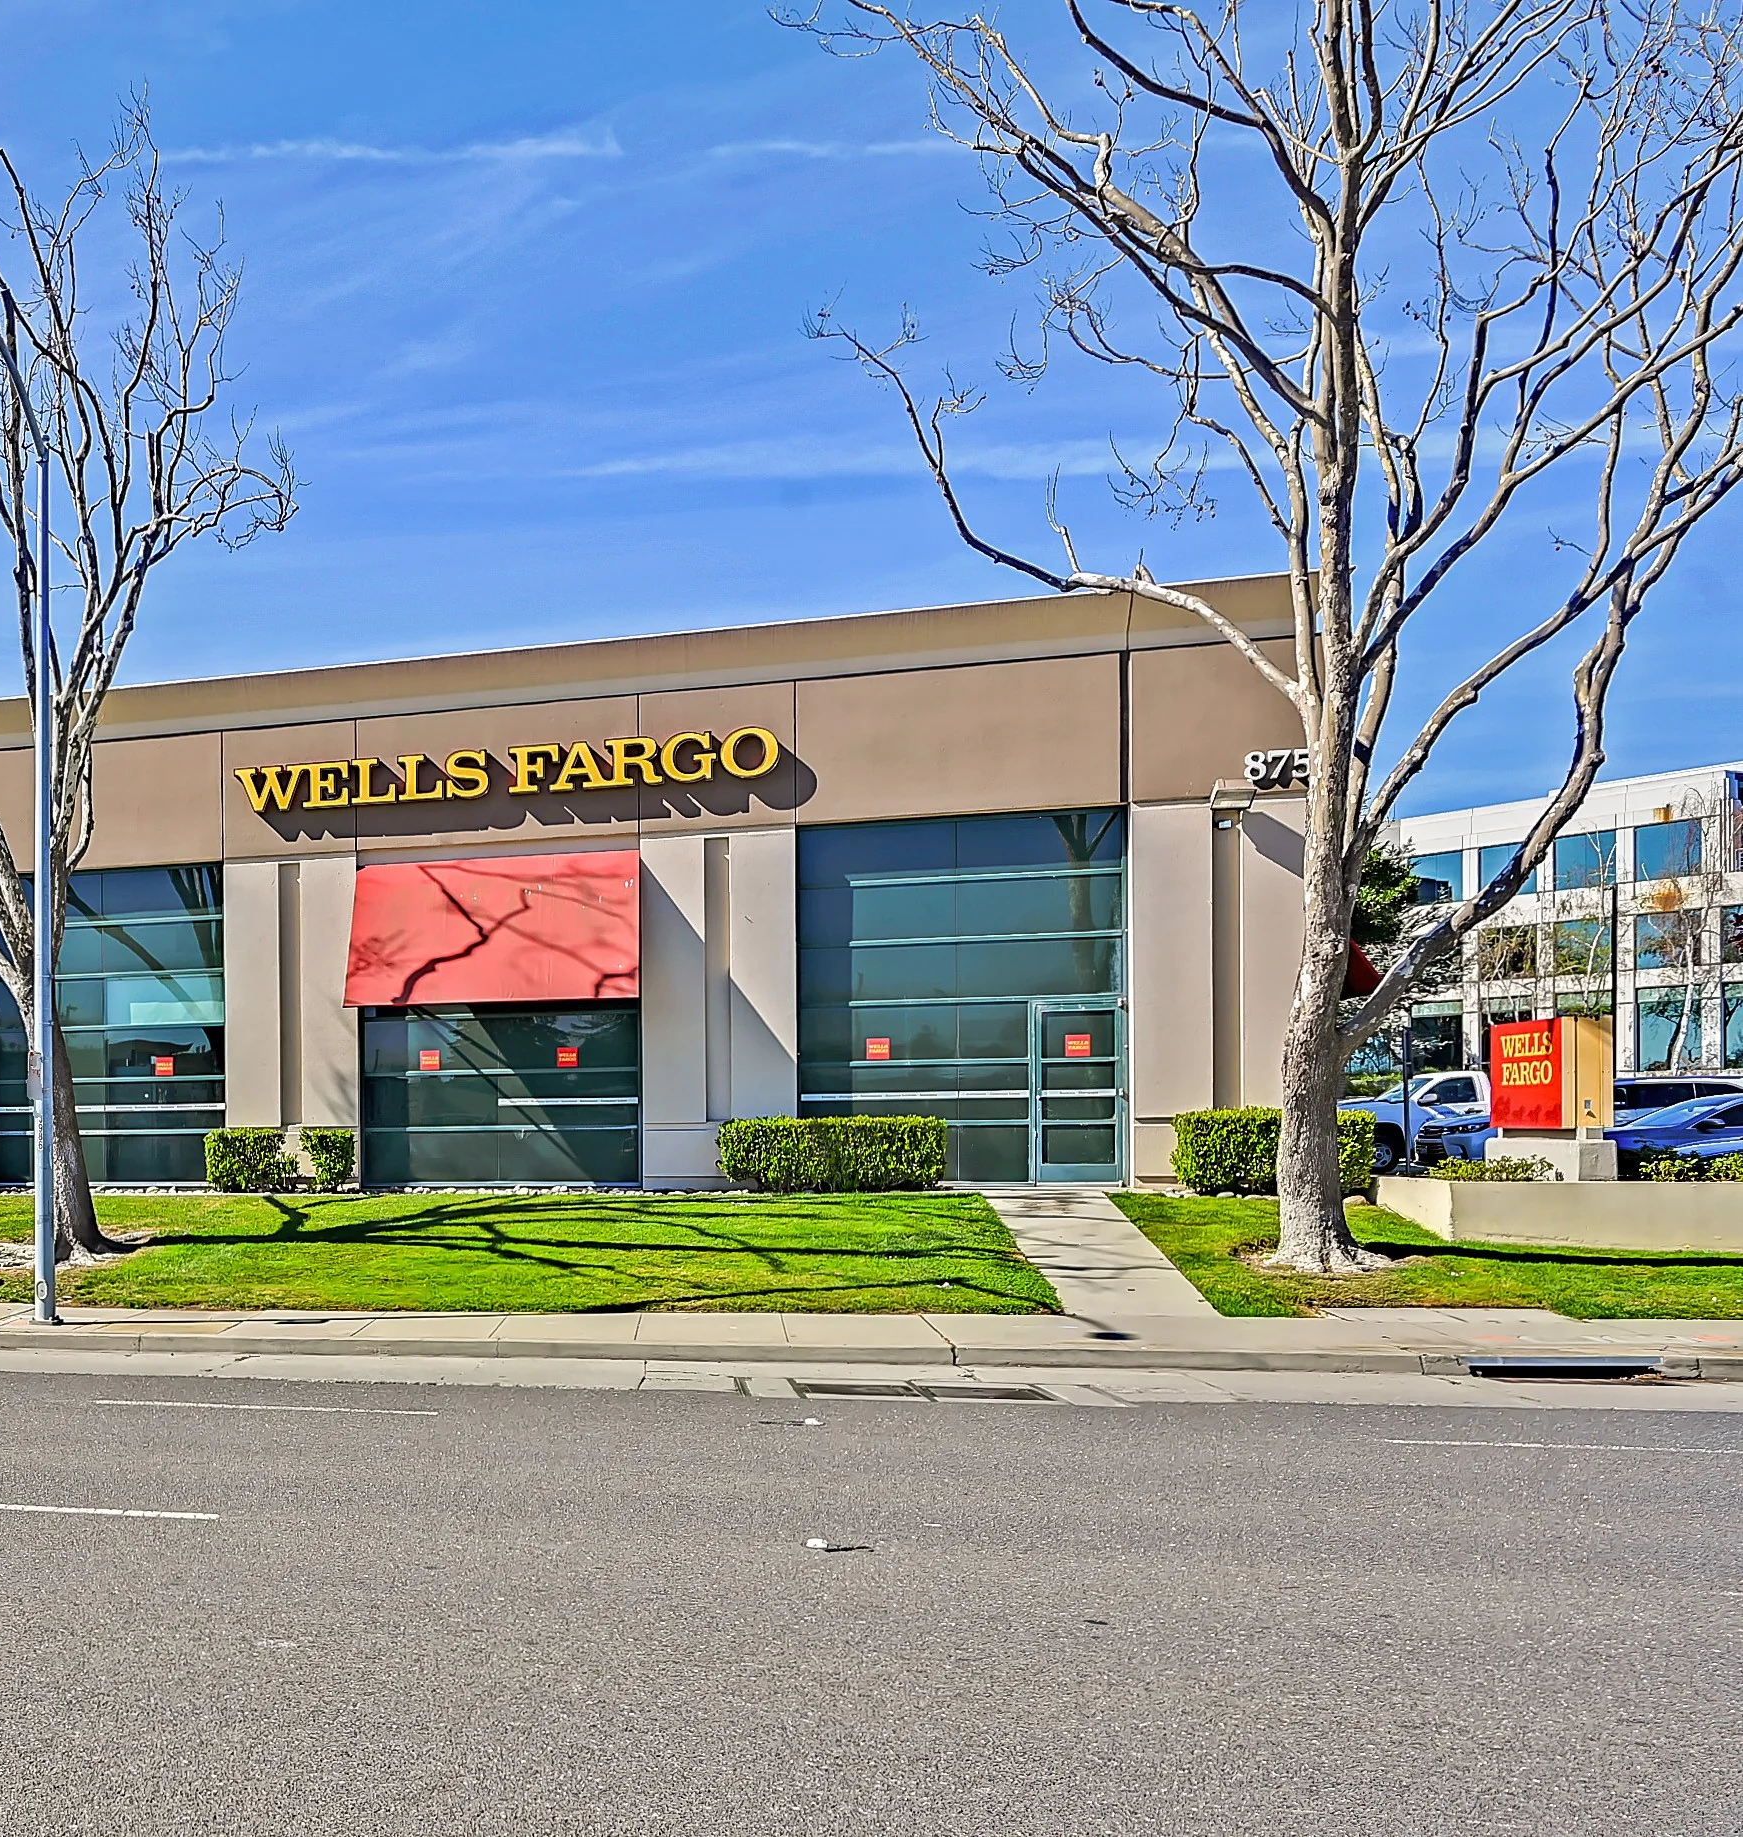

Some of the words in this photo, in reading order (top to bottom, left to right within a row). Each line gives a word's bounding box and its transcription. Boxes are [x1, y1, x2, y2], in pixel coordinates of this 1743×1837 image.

[234, 749, 491, 813] WELLS
[508, 726, 782, 796] FARGO
[1243, 748, 1310, 781] 875
[1500, 1031, 1553, 1058] WELLS
[1501, 1060, 1553, 1086] FARGO
